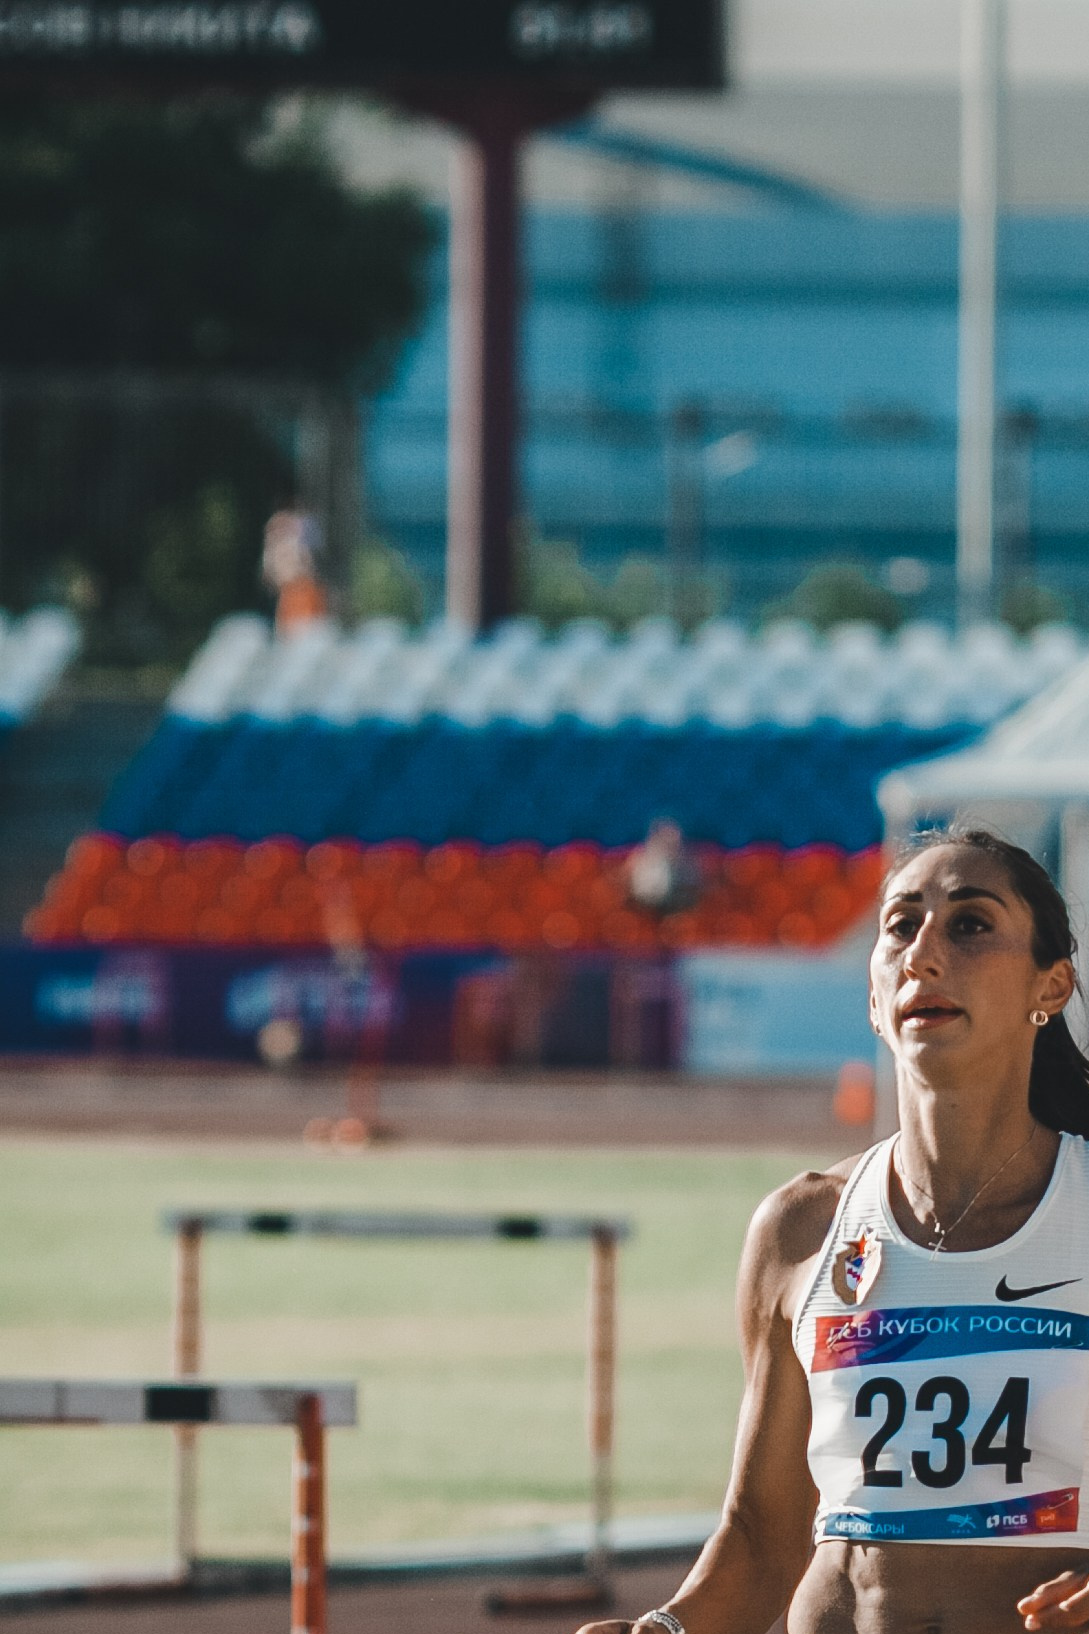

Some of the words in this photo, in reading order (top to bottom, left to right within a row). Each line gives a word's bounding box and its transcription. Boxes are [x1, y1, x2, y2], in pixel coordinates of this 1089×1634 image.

[879, 1316, 960, 1336] КУБОК
[969, 1315, 1072, 1338] РОССИИ
[854, 1376, 1031, 1488] 234
[835, 1521, 905, 1534] ЧЕБОКСАРЫ
[1002, 1514, 1028, 1526] ПСБ
